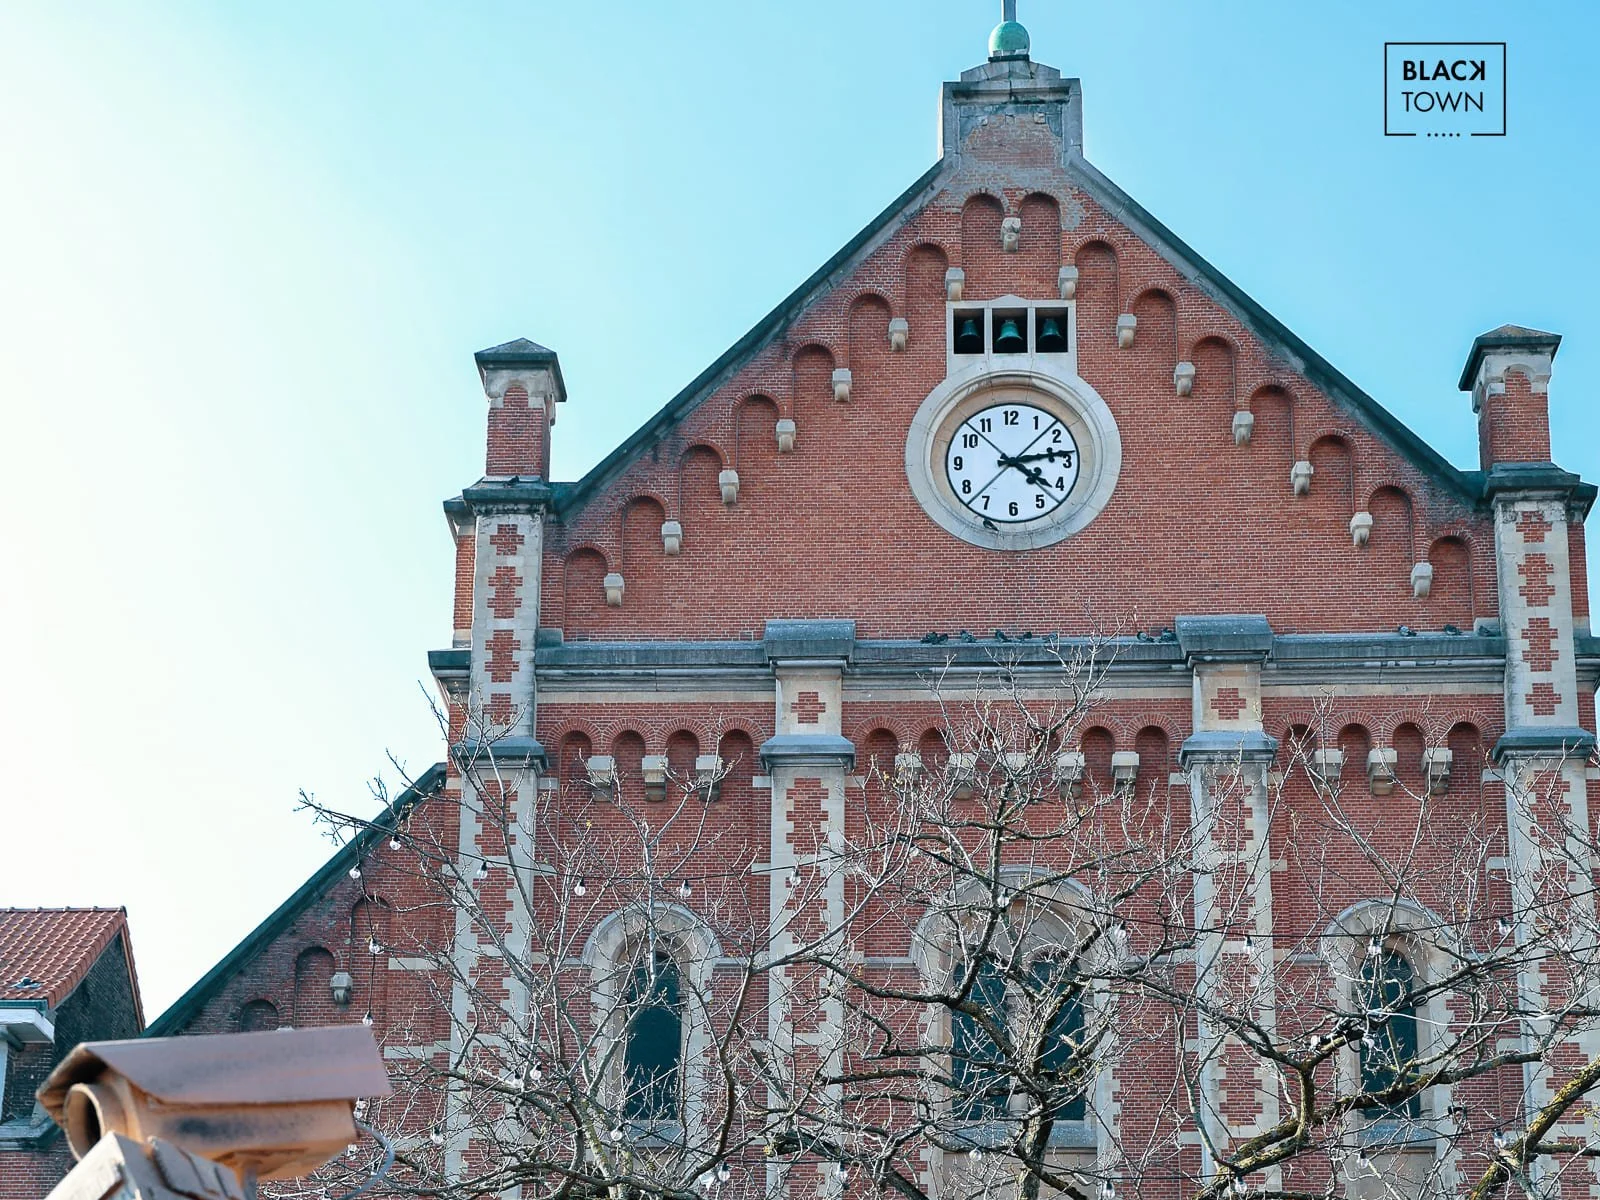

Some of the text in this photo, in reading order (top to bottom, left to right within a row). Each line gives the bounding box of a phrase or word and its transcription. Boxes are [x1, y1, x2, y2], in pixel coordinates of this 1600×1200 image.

[979, 418, 992, 433] 11
[1003, 410, 1019, 426] 12
[1033, 415, 1039, 430] 1
[962, 433, 979, 448] 10
[1052, 429, 1062, 443] 2
[953, 456, 963, 471] 9
[1062, 454, 1072, 469] 3
[962, 479, 972, 494] 8
[1055, 476, 1065, 491] 4
[982, 495, 990, 510] 7
[1008, 501, 1018, 516] 6
[1035, 494, 1045, 509] 5
